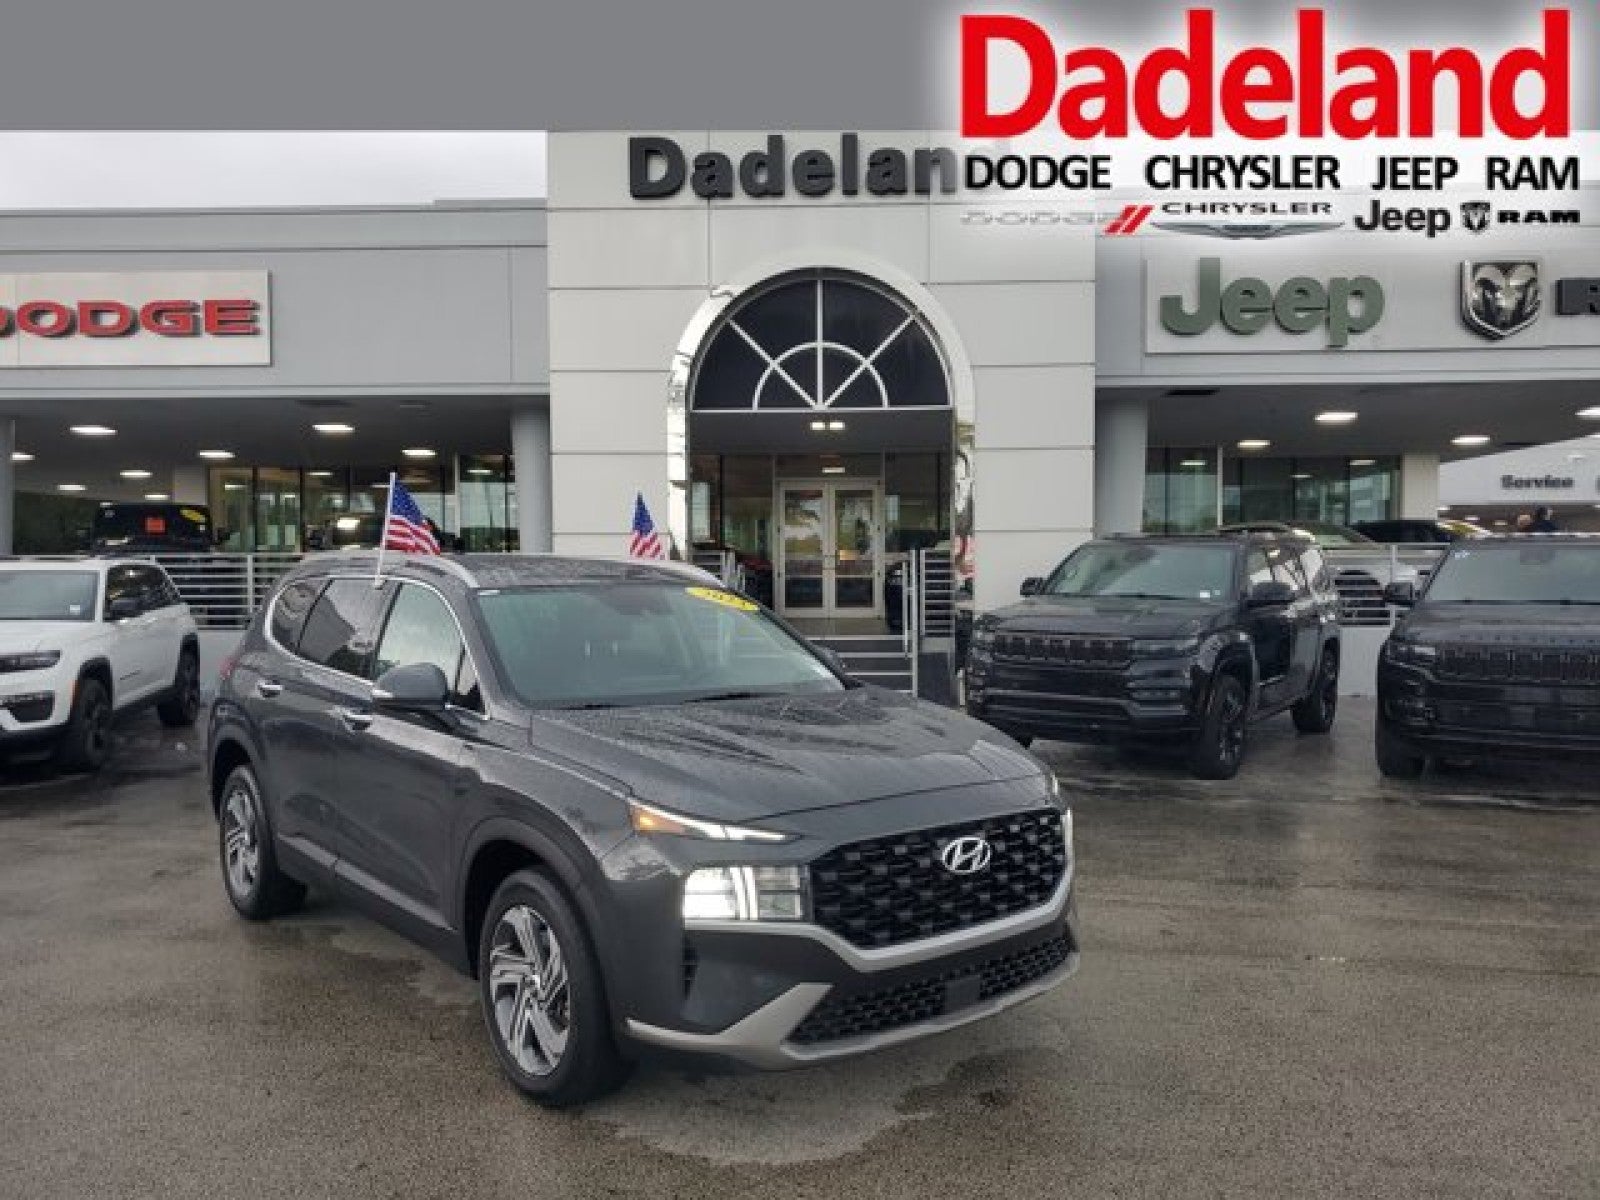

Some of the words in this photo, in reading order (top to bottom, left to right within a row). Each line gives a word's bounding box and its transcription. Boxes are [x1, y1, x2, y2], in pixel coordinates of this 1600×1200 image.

[627, 132, 1010, 200] Dadelan
[0, 299, 260, 337] ODGE
[1159, 257, 1385, 348] Jeep
[1501, 474, 1574, 490] Service
